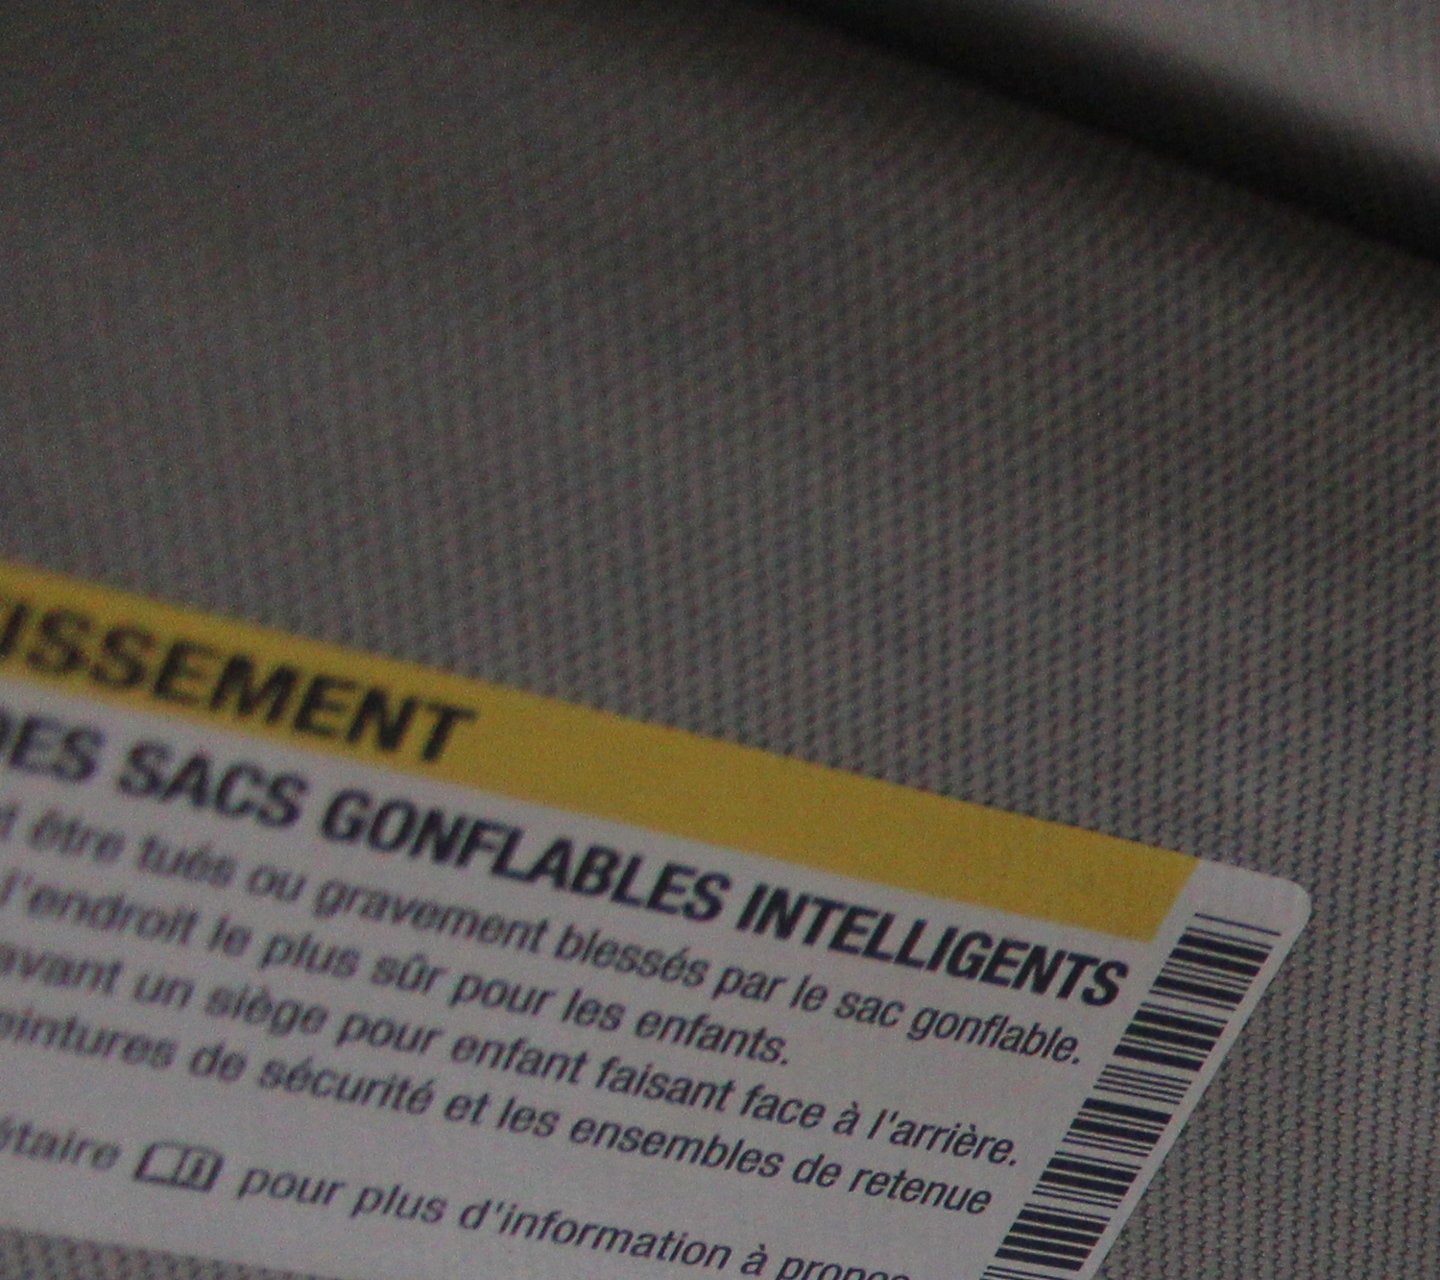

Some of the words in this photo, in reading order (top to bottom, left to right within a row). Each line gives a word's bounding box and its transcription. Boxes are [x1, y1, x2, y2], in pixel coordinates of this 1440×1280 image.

[0, 603, 478, 764] ISSEMENT
[0, 867, 198, 945] l'endroit
[208, 915, 252, 957] le
[260, 930, 360, 978] plus
[370, 952, 447, 997] sûr
[448, 971, 556, 1019] pour
[561, 986, 627, 1033] les
[634, 1009, 789, 1066] enfants.
[28, 808, 126, 865] être
[137, 833, 238, 891] tués
[246, 863, 306, 903] ou
[313, 878, 550, 954] gravement
[555, 924, 710, 988] blessés
[713, 964, 788, 1001] par
[789, 974, 828, 1012] le
[834, 990, 906, 1028] sac
[907, 1004, 1081, 1066] gonflable.
[116, 739, 308, 829] SACS
[320, 789, 731, 922] GONFLABLES
[736, 883, 1130, 1007] INTELLIGENTS
[134, 971, 195, 1008] un
[205, 983, 328, 1038] siège
[336, 1011, 444, 1055] pour
[450, 1034, 589, 1086] enfant
[595, 1055, 736, 1112] faisant
[739, 1083, 827, 1130] face
[832, 1101, 861, 1137] à
[866, 1108, 1019, 1168] l'arrière.
[190, 1041, 247, 1082] de
[258, 1055, 434, 1115] sécurité
[444, 1090, 489, 1125] et
[497, 1097, 560, 1138] les
[569, 1116, 784, 1179] ensembles
[792, 1153, 842, 1189] de
[848, 1167, 992, 1216] retenue
[238, 1167, 348, 1208] pour
[350, 1182, 449, 1225] plus
[458, 1199, 732, 1272] d'information
[740, 1243, 769, 1278] à
